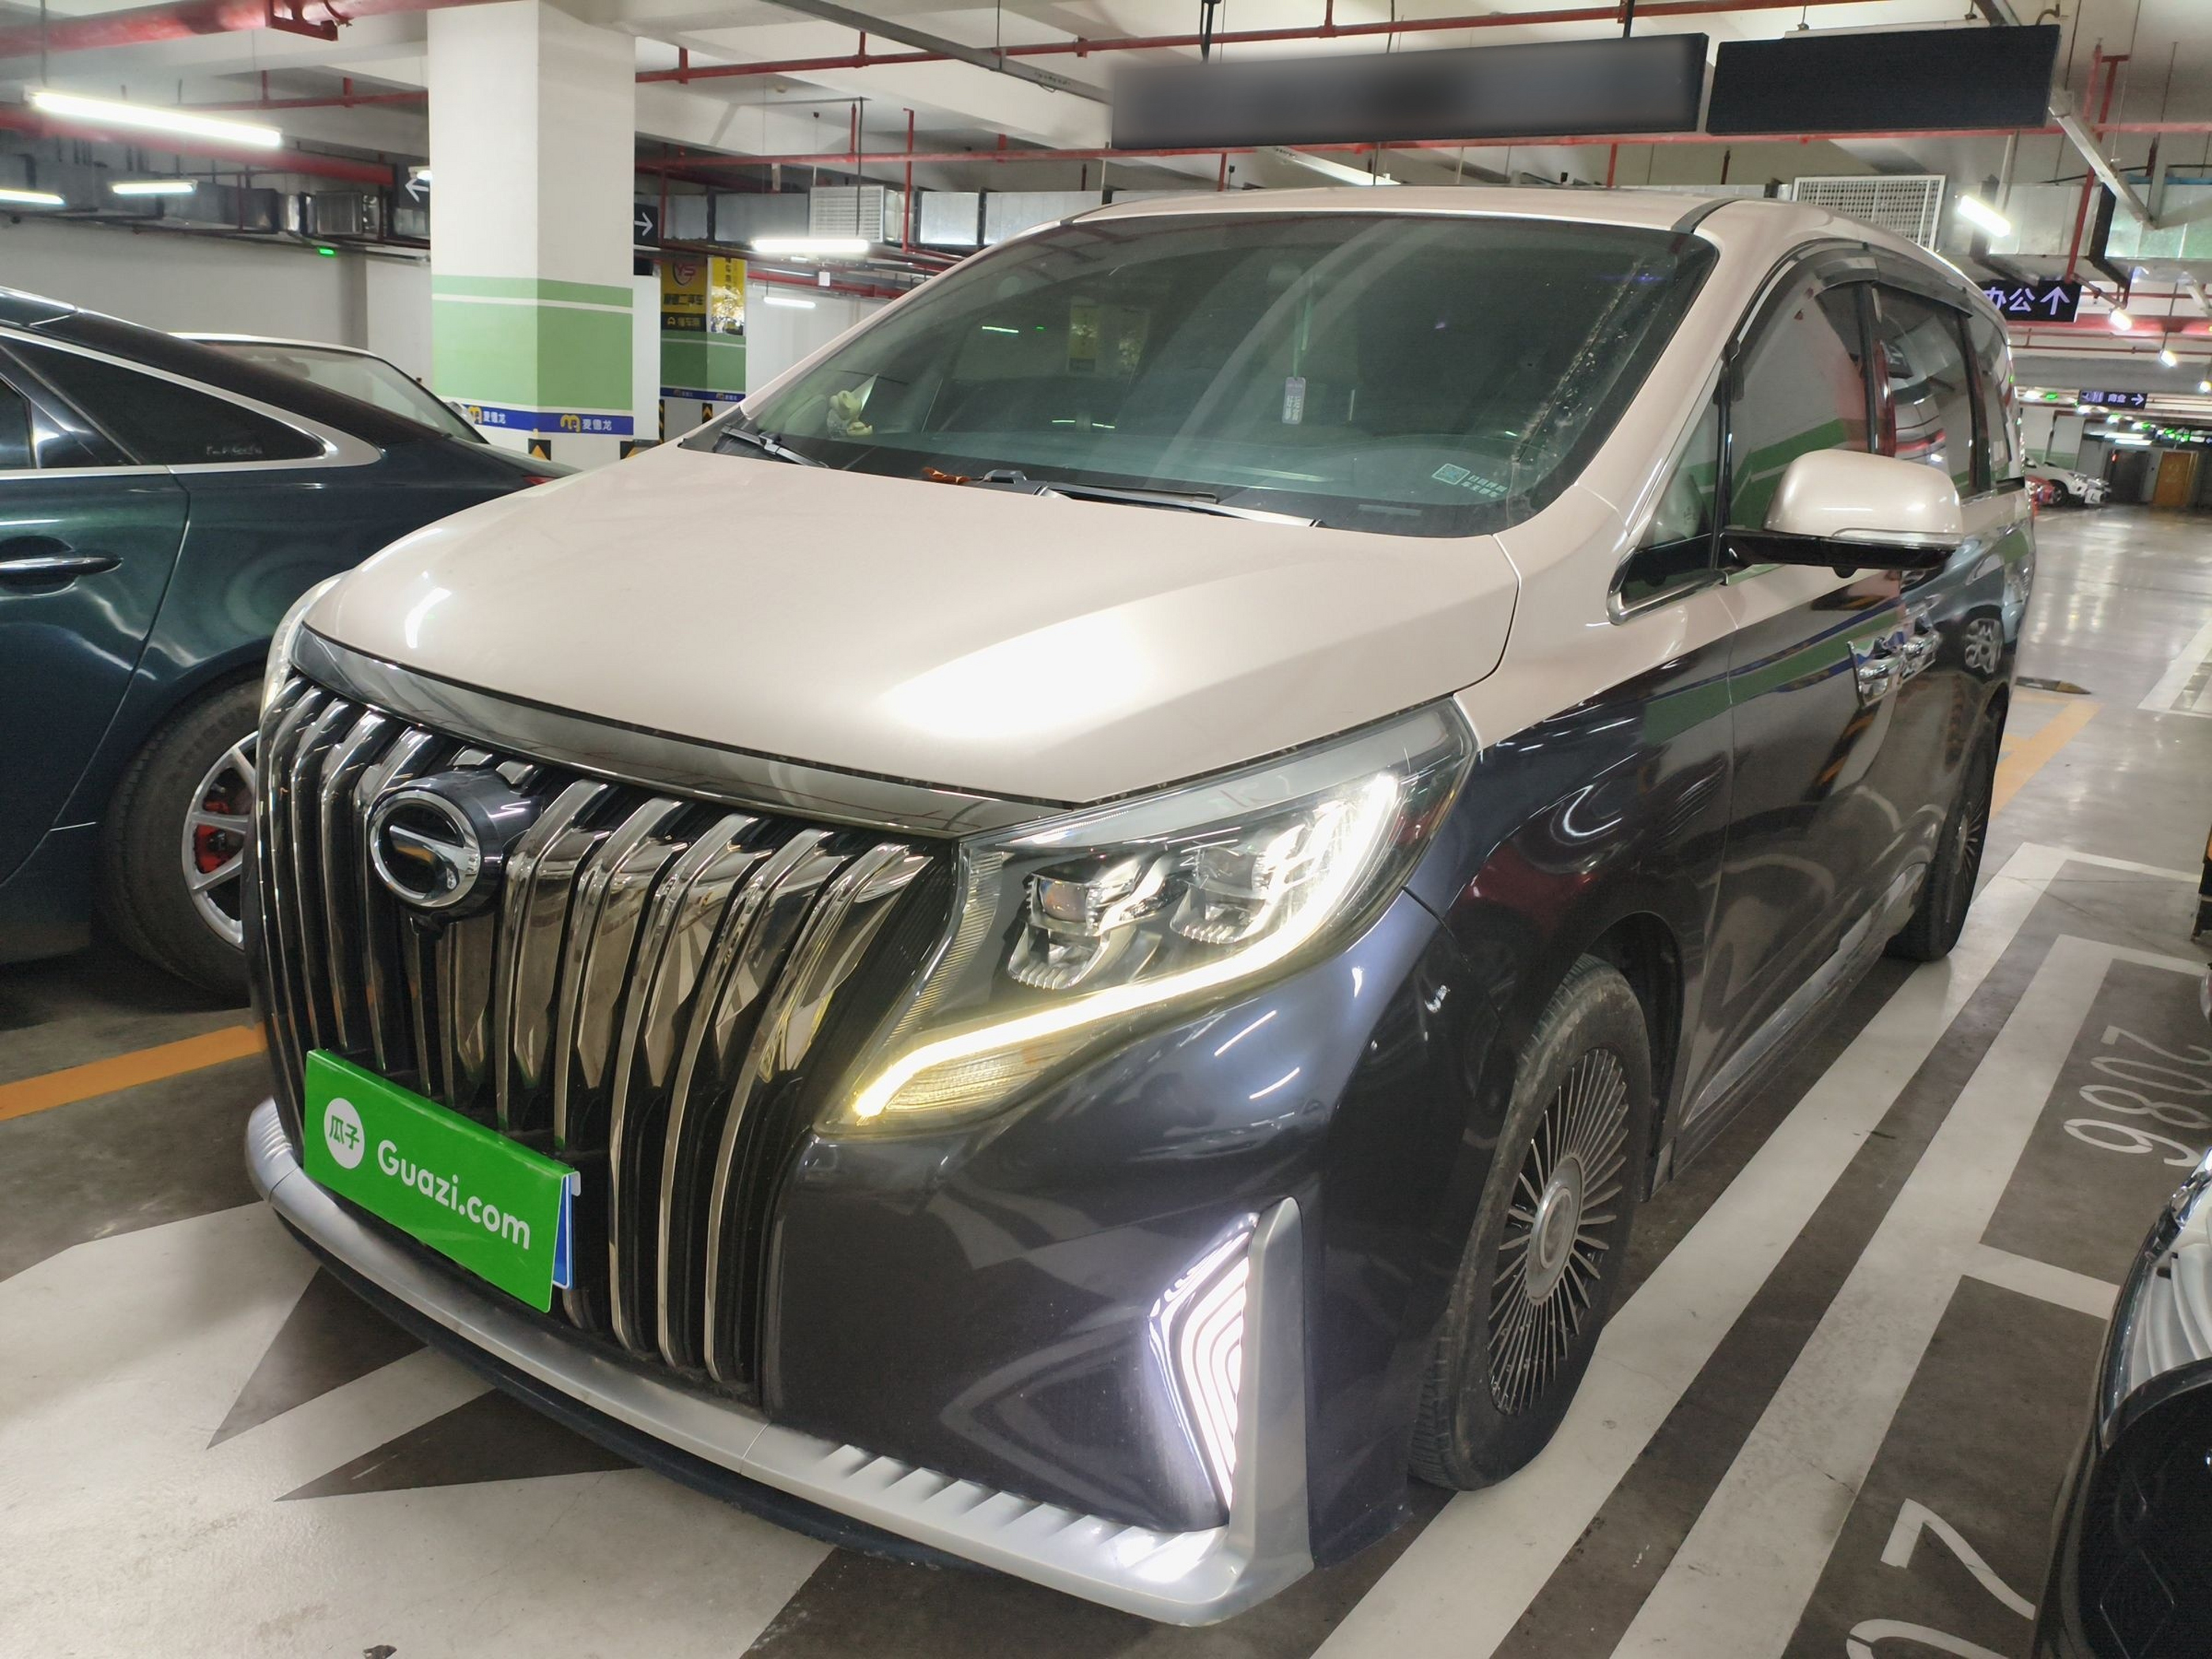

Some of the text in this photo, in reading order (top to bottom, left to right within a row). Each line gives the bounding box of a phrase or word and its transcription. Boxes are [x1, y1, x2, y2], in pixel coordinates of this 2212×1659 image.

[1983, 287, 2035, 312] 办公
[329, 1115, 360, 1150] 瓜子
[377, 1139, 531, 1250] Guazi.com
